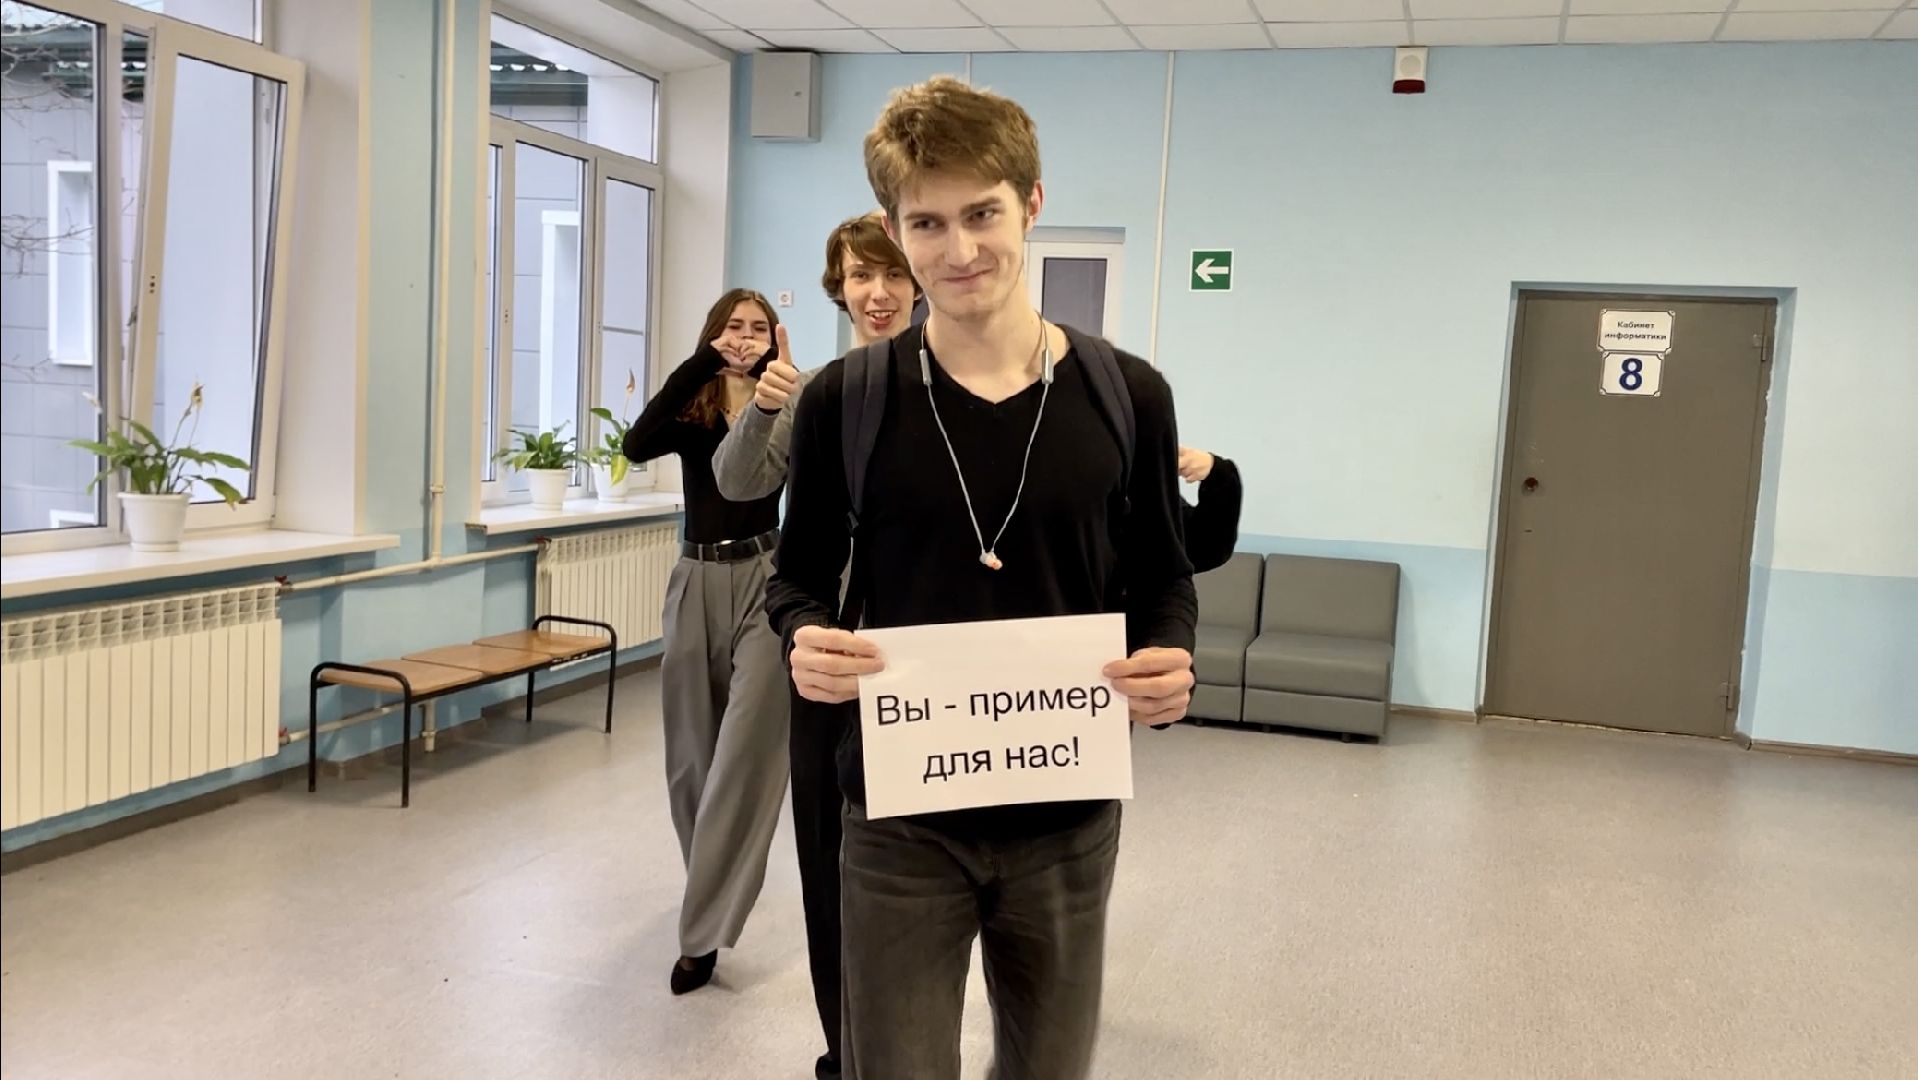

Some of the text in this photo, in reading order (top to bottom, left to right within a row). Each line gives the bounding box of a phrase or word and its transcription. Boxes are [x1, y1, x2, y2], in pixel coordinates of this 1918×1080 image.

[1617, 321, 1655, 329] Кабинет
[1619, 358, 1643, 391] 8
[876, 694, 931, 726] Вы
[969, 684, 1111, 722] пример
[922, 736, 1080, 784] для нас!
